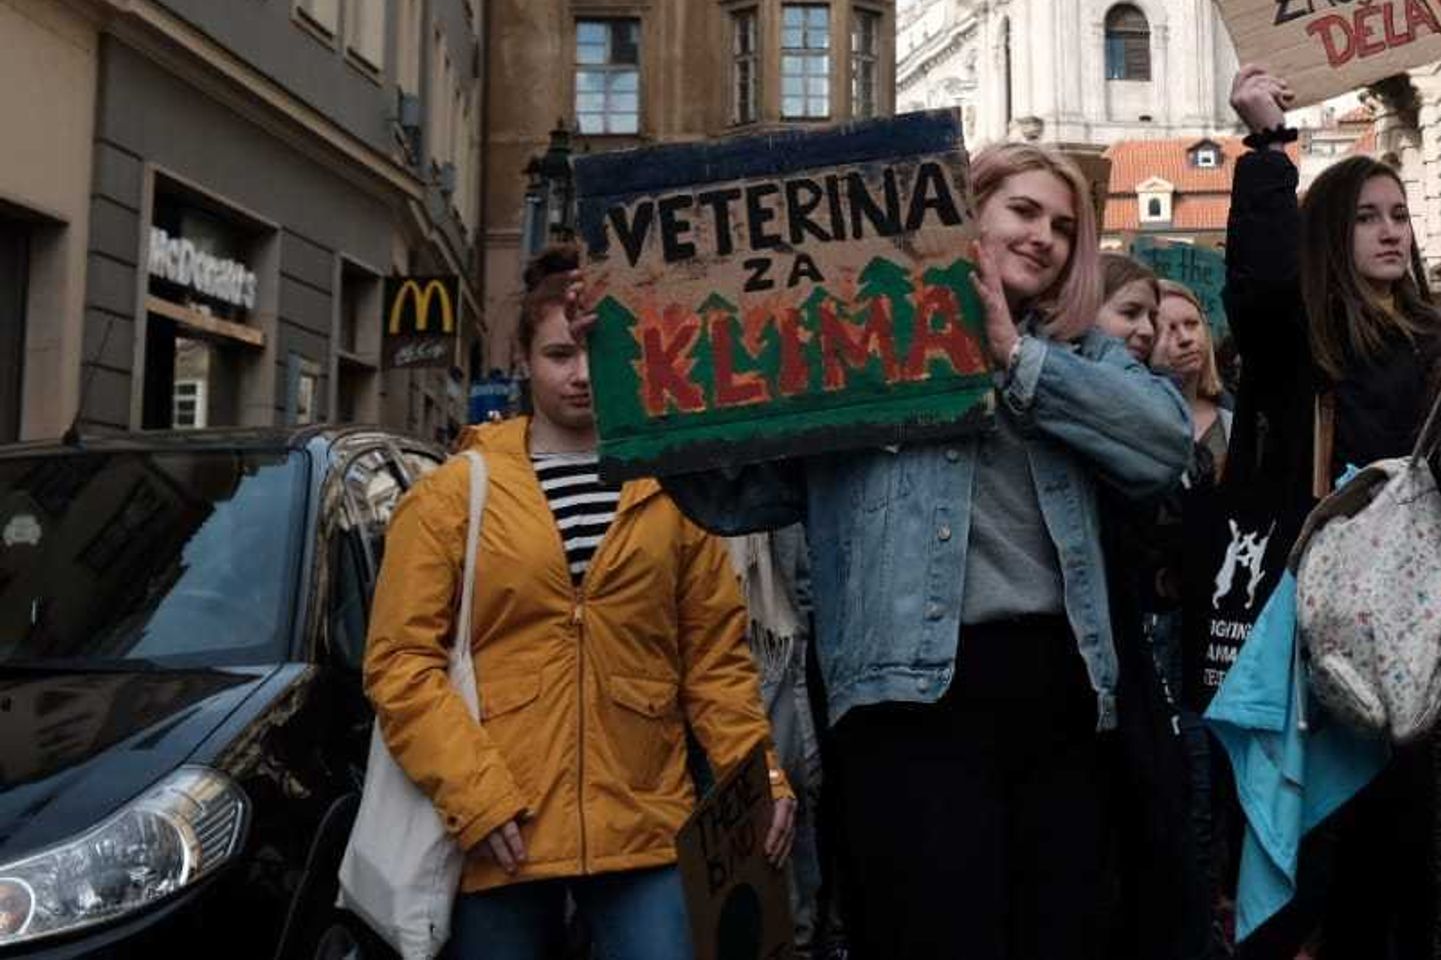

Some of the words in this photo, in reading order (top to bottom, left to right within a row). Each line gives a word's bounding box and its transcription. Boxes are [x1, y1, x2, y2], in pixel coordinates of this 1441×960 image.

[608, 161, 963, 269] VETERINA
[742, 252, 825, 294] ZA
[640, 286, 987, 418] KLIMA
